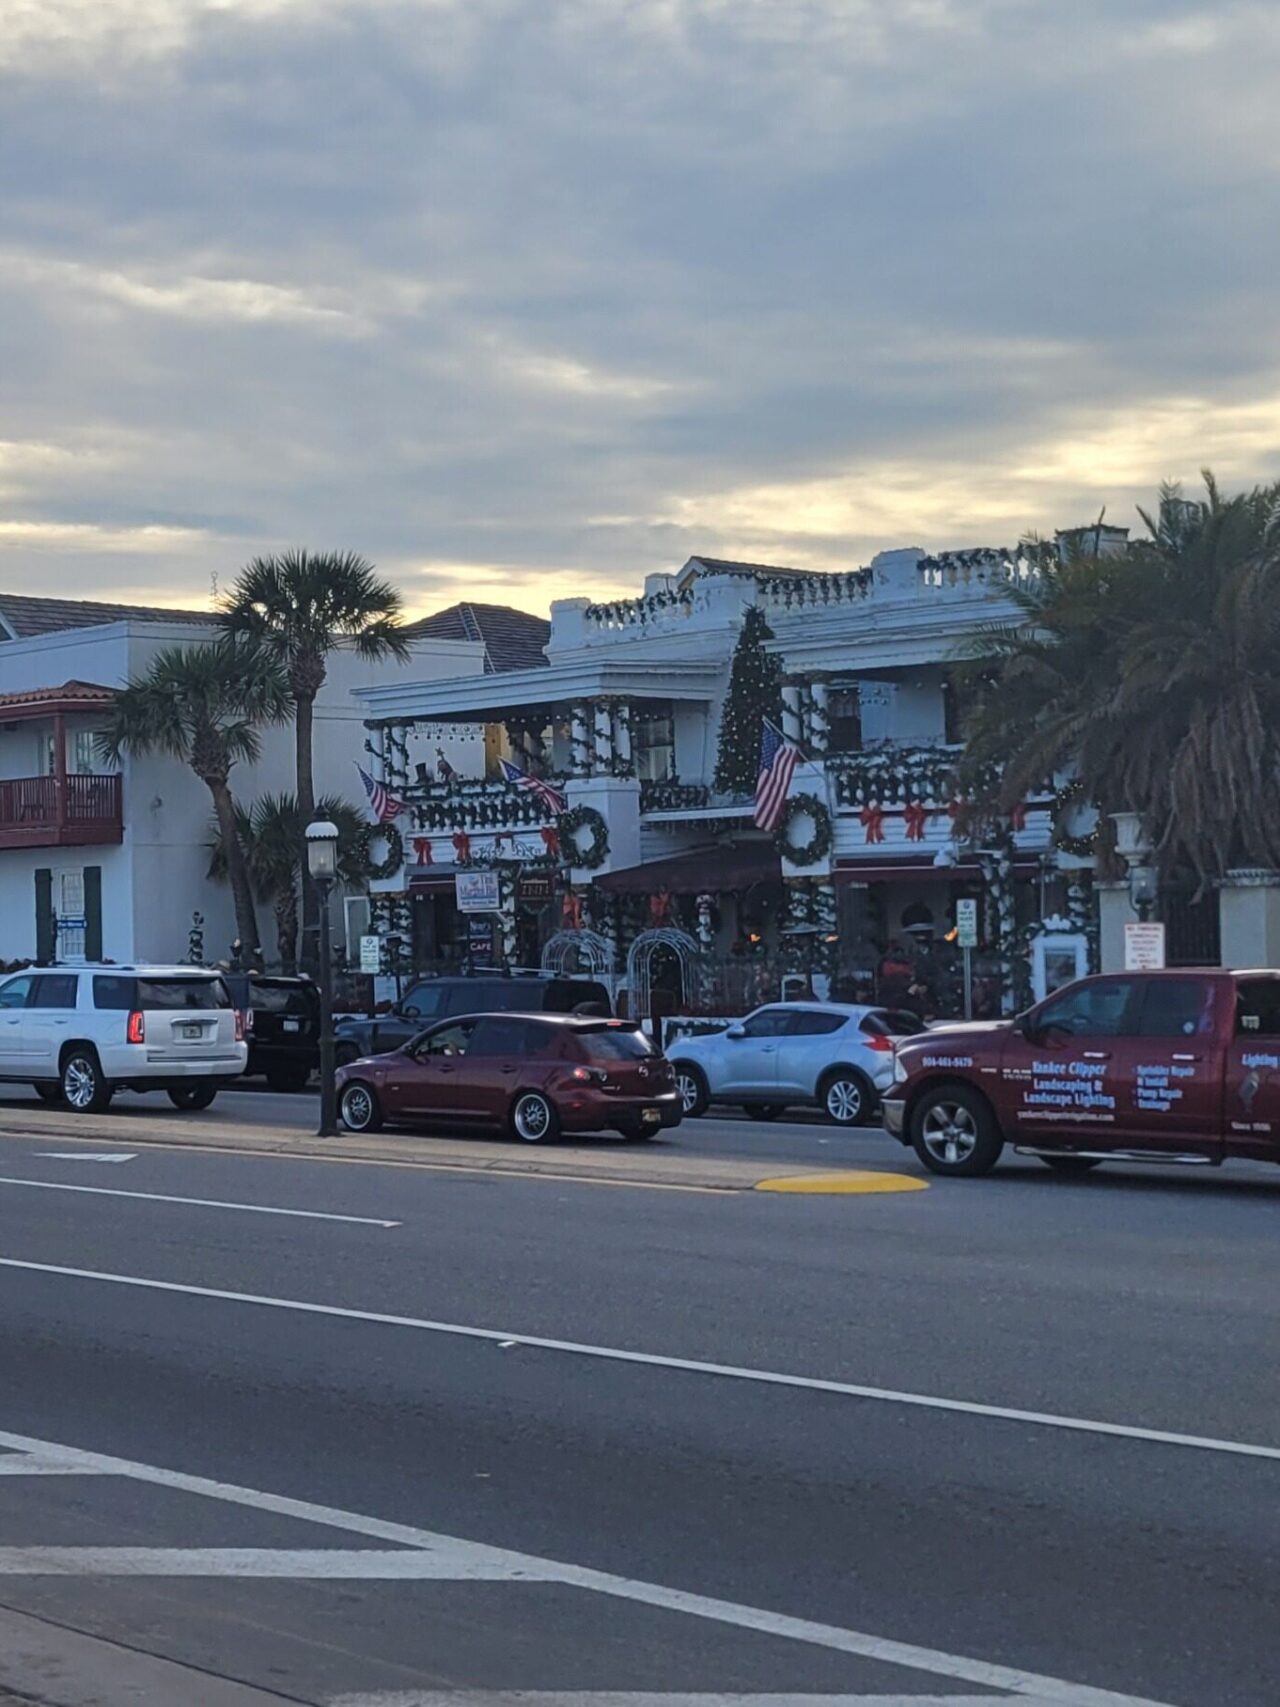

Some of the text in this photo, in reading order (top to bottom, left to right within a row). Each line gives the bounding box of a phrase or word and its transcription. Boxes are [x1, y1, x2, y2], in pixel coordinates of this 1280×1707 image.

[1032, 1061, 1107, 1078] Yankee Clipper
[1033, 1078, 1093, 1094] Landscaping
[1023, 1091, 1115, 1109] Landscape Lighting
